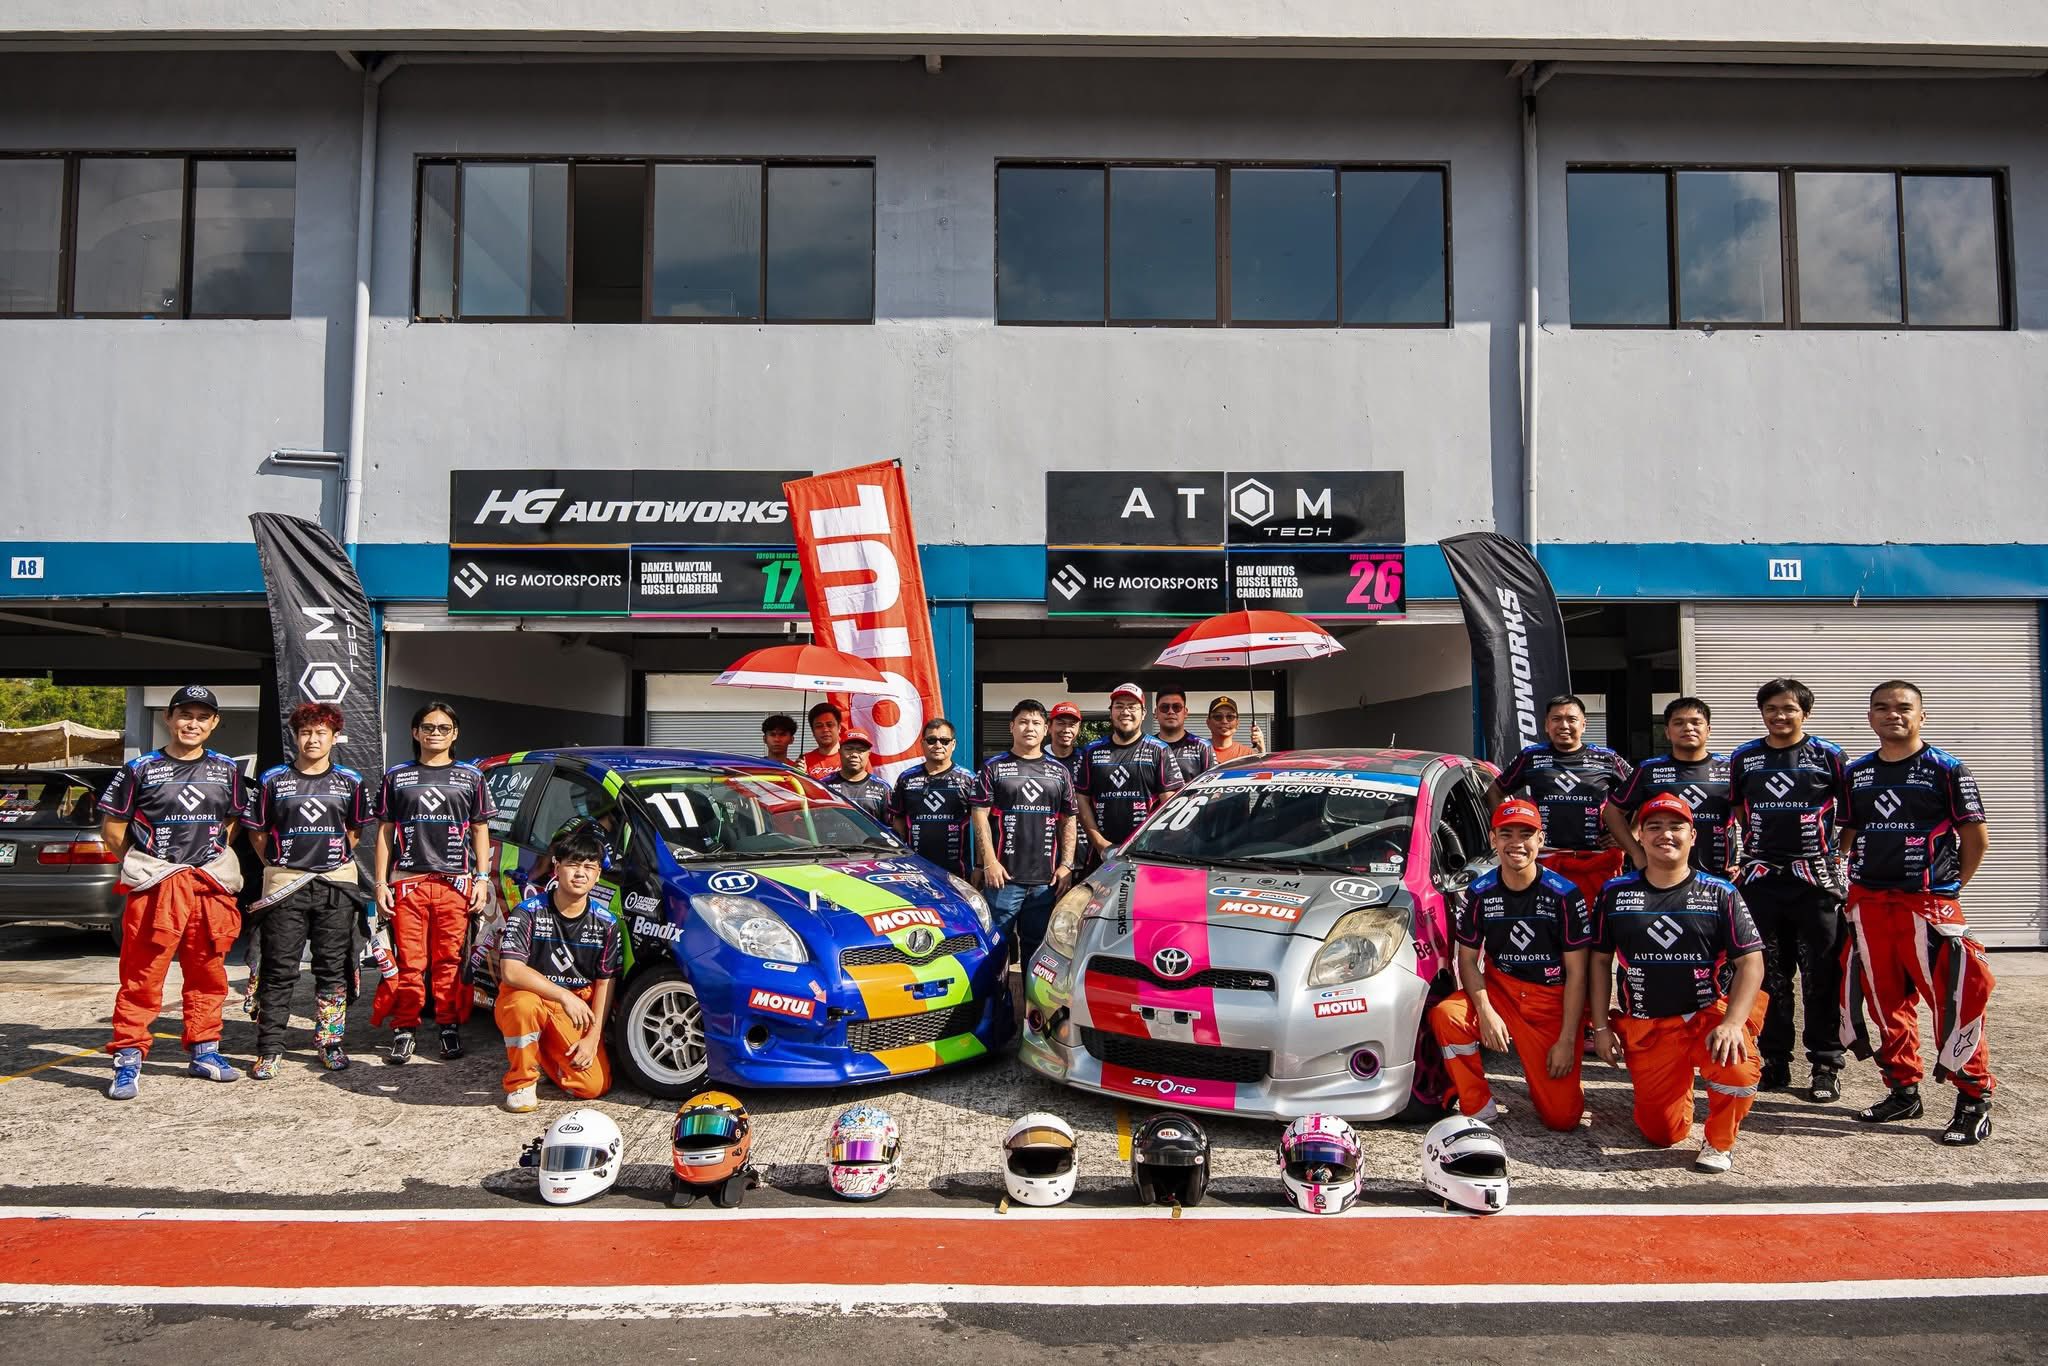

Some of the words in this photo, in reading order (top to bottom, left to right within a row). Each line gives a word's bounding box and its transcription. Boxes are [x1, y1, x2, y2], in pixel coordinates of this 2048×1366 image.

[474, 489, 565, 524] HG
[560, 501, 789, 524] AUTOWORKS
[1264, 527, 1332, 537] TECH
[17, 560, 37, 575] A8
[641, 562, 674, 573] DANZEL
[674, 561, 712, 572] WAYTAN
[1236, 566, 1254, 576] GAV
[1256, 566, 1295, 577] QUINTOS
[1774, 562, 1797, 578] A11
[495, 574, 518, 587] HG
[521, 574, 622, 587] MOTORSPORTS
[641, 573, 663, 583] PAUL
[665, 572, 722, 583] MONASTRIAL
[762, 560, 802, 603] 17
[1093, 577, 1115, 589] HG
[1119, 576, 1218, 590] MOTORSPORTS
[1236, 577, 1270, 587] RUSSEL
[1271, 577, 1298, 587] REYES
[1346, 561, 1403, 604] 26
[641, 584, 675, 595] RUSSEL
[676, 584, 718, 594] CABRERA
[1236, 588, 1271, 599] CARLOS
[1272, 588, 1303, 598] MARZO
[1197, 786, 1258, 795] TUASON
[1263, 785, 1325, 795] RACING
[1328, 787, 1400, 802] SCHOOL
[644, 791, 699, 829] 17
[1147, 796, 1209, 831] 26
[1220, 902, 1297, 919] MOTUL
[633, 915, 685, 942] Bendix
[875, 909, 941, 932] MOTUL
[1634, 953, 1702, 961] AUTOWORKS
[1033, 965, 1054, 983] MOTUL
[752, 993, 810, 1015] MOTUL
[1318, 1000, 1365, 1016] MOTUL
